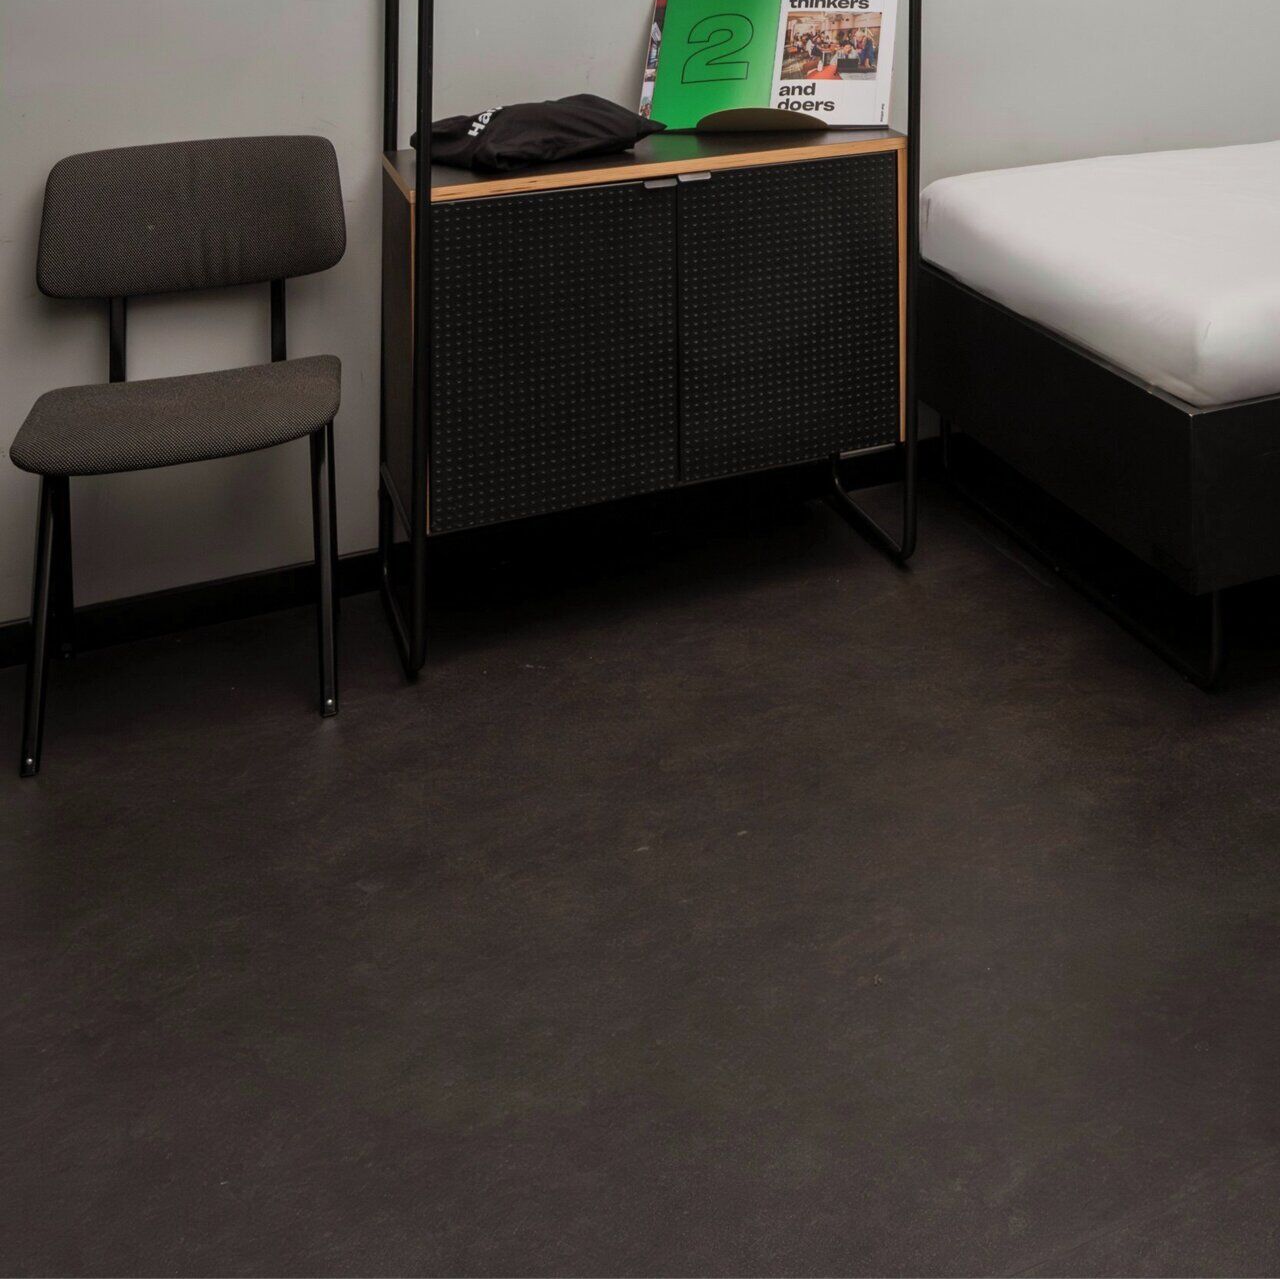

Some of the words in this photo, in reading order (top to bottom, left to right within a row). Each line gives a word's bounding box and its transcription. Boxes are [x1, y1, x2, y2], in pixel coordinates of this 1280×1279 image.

[681, 13, 754, 84] 2
[778, 82, 817, 97] and
[777, 98, 836, 111] doers
